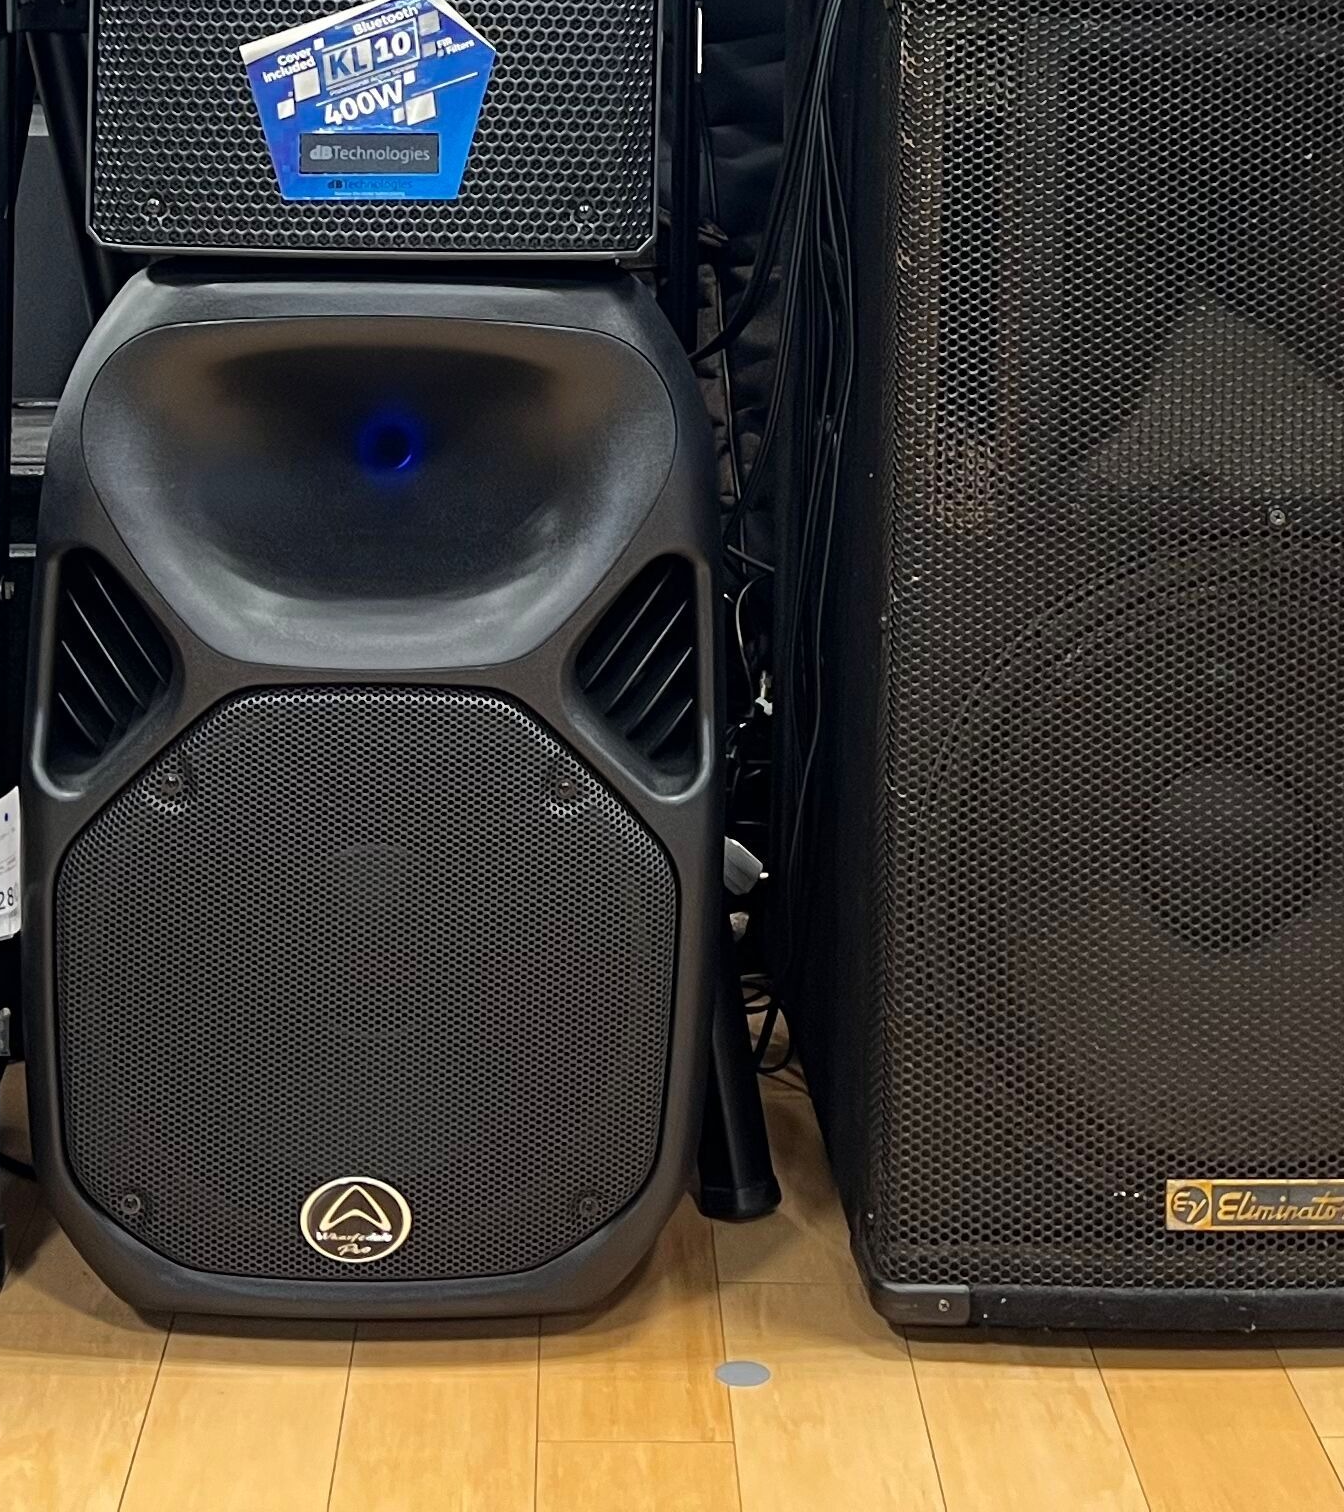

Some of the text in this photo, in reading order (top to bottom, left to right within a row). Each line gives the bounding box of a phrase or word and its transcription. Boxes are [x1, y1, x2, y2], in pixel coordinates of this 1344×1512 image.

[352, 4, 419, 36] Bluetooth
[262, 56, 317, 85] Included
[277, 47, 313, 67] Cover
[323, 80, 405, 127] 400W
[309, 144, 431, 164] dBTechnologies
